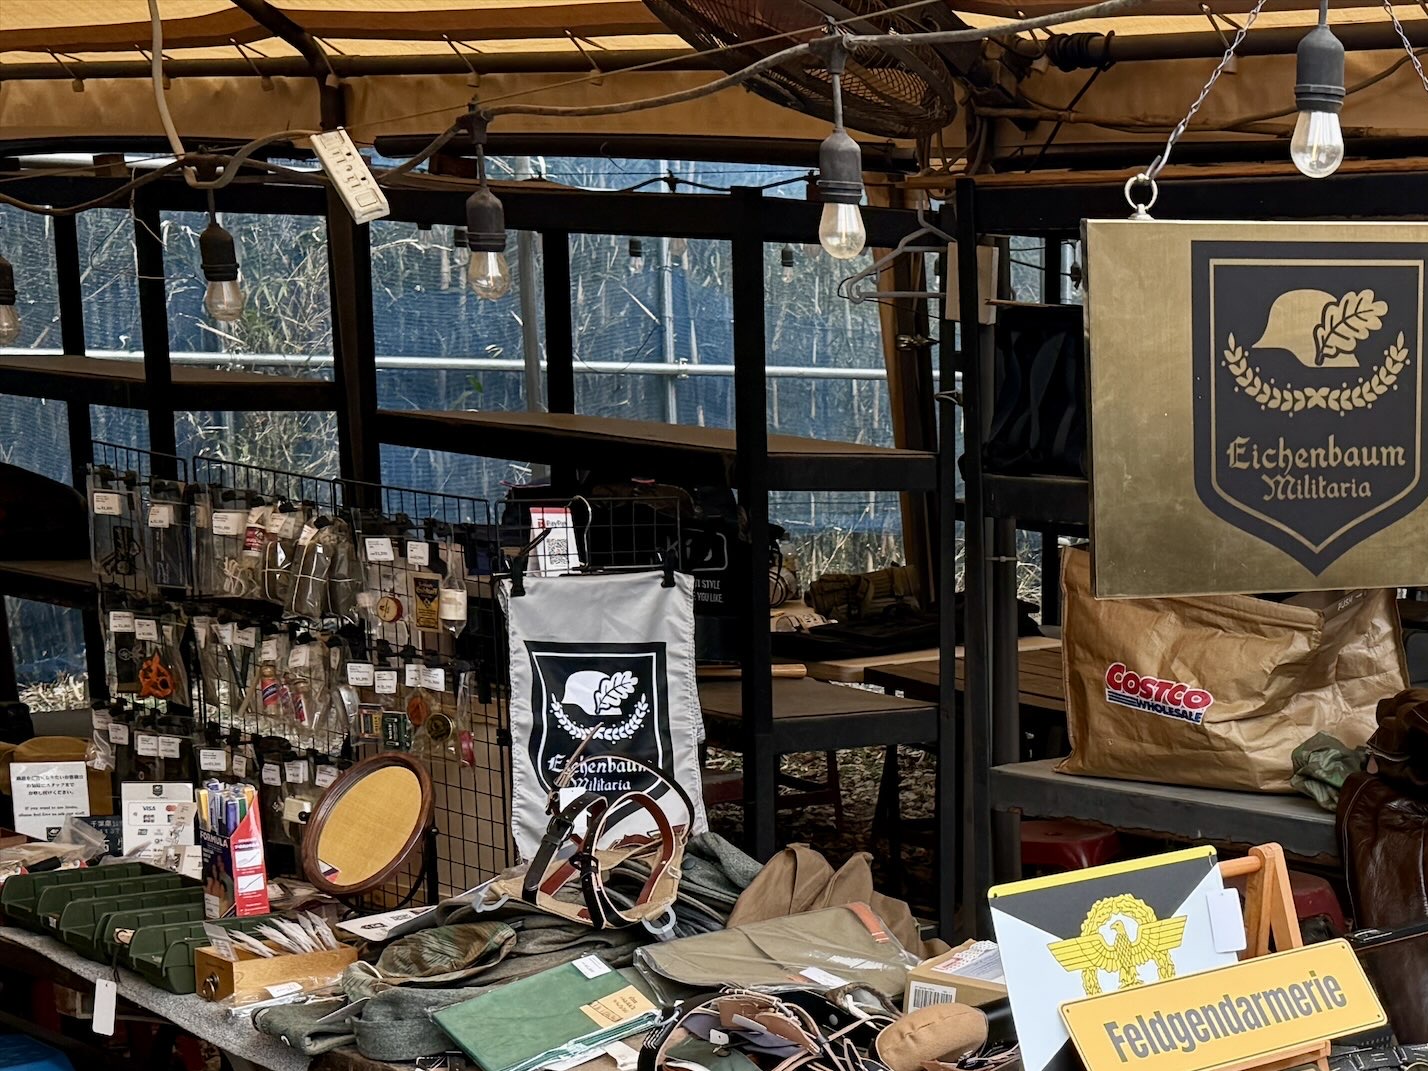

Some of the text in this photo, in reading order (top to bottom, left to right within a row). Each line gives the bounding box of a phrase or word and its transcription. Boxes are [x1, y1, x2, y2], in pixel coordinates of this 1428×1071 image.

[1226, 434, 1406, 476] Eichenbaum
[1261, 473, 1372, 501] Militaria
[1106, 663, 1212, 709] COSTCO
[1136, 698, 1203, 722] WHOLESALE
[547, 753, 652, 777] Echenbau
[571, 776, 632, 792] Militaria
[200, 830, 229, 848] FORMULA
[1104, 970, 1348, 1063] Feldgendarmerie
